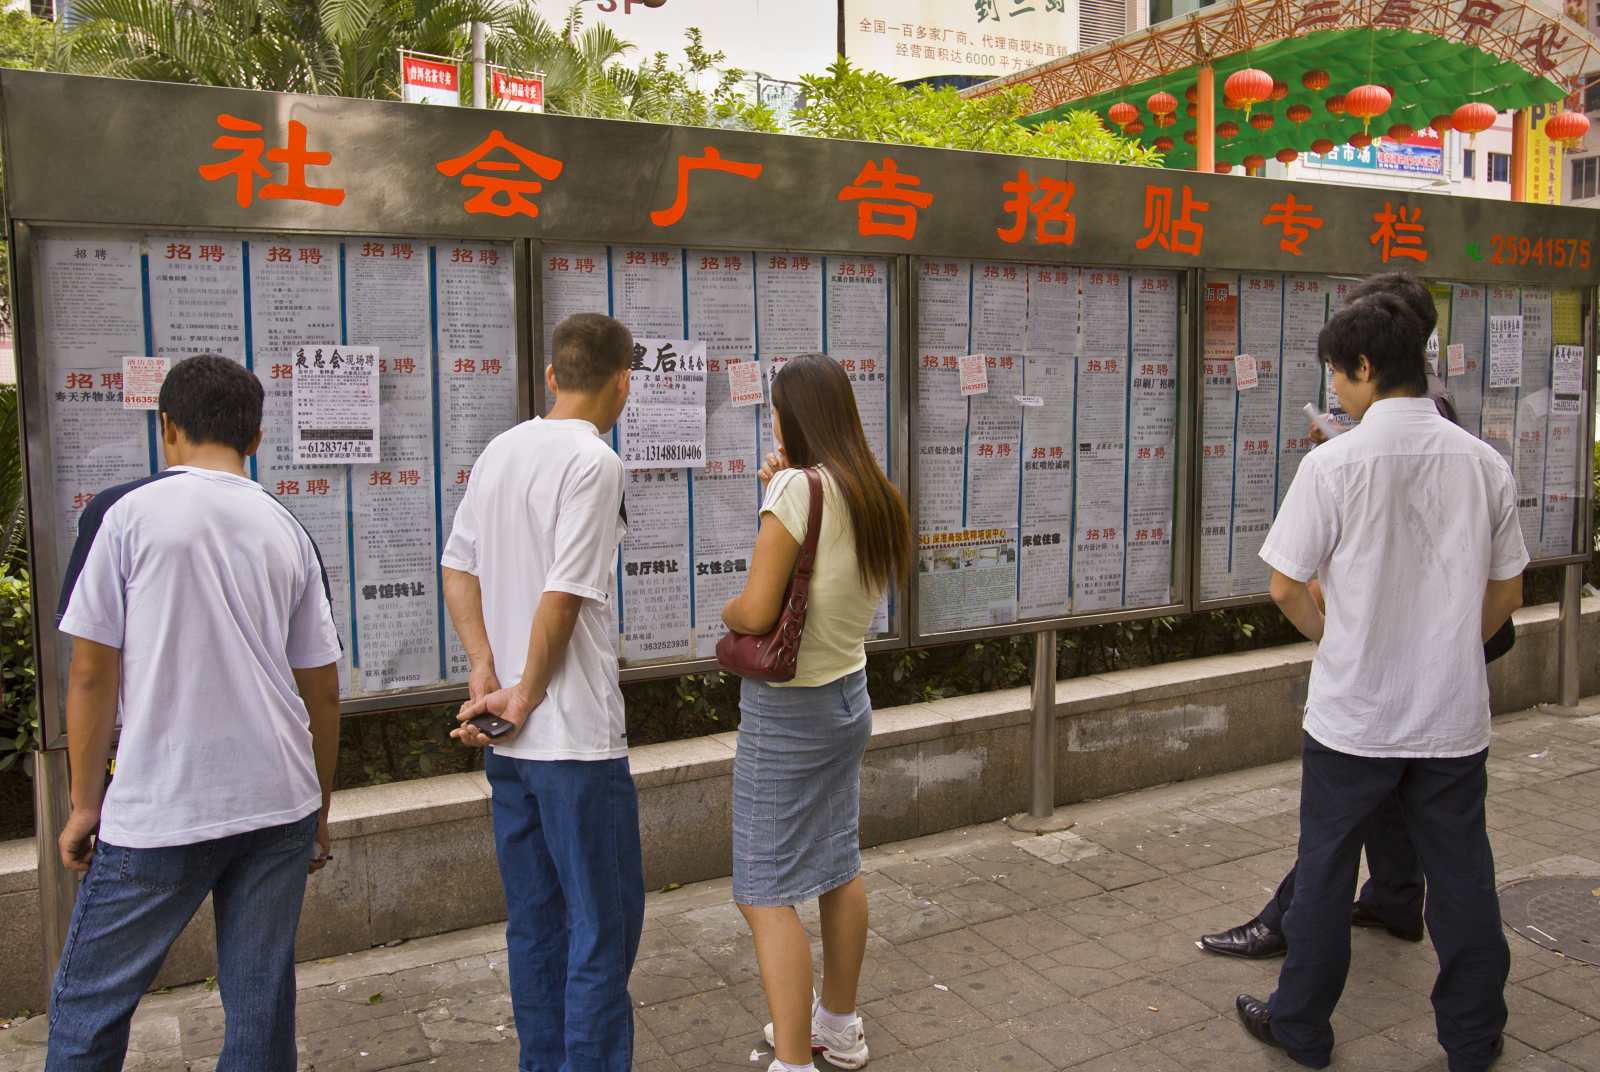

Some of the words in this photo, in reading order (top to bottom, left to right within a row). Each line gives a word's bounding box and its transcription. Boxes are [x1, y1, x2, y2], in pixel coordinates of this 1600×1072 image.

[965, 52, 996, 67] 6000
[199, 112, 1429, 263] 社会广告招贴专栏
[1489, 234, 1591, 270] 25941575
[166, 243, 225, 262] 招聘
[266, 246, 322, 264] 招聘
[361, 241, 414, 260] 招聘
[451, 247, 500, 266] 招聘
[549, 256, 596, 273] 招聘
[626, 252, 671, 267] 招聘
[701, 256, 743, 272] 招聘
[769, 256, 811, 272] 招聘
[923, 263, 960, 277] 招聘
[983, 265, 1017, 280] 招聘
[1037, 270, 1069, 285] 招聘
[1089, 271, 1121, 286] 招聘
[1140, 278, 1169, 290] 招聘
[454, 356, 502, 375] 招聘
[1087, 359, 1118, 372] 招聘
[1140, 363, 1169, 376] 招聘
[308, 441, 354, 453] 61283747
[645, 444, 702, 461] 13148810406
[976, 442, 1012, 457] 招聘
[1032, 446, 1064, 459] 招聘
[1137, 447, 1166, 460] 招聘
[704, 459, 746, 474] 招聘
[368, 469, 422, 486] 招聘
[277, 479, 331, 497] 招聘
[1085, 527, 1116, 541] 招聘
[1135, 528, 1164, 541] 招聘
[625, 560, 679, 577] 餐厅转让
[696, 558, 748, 577] 女性合租
[362, 580, 426, 601] 餐馆转让
